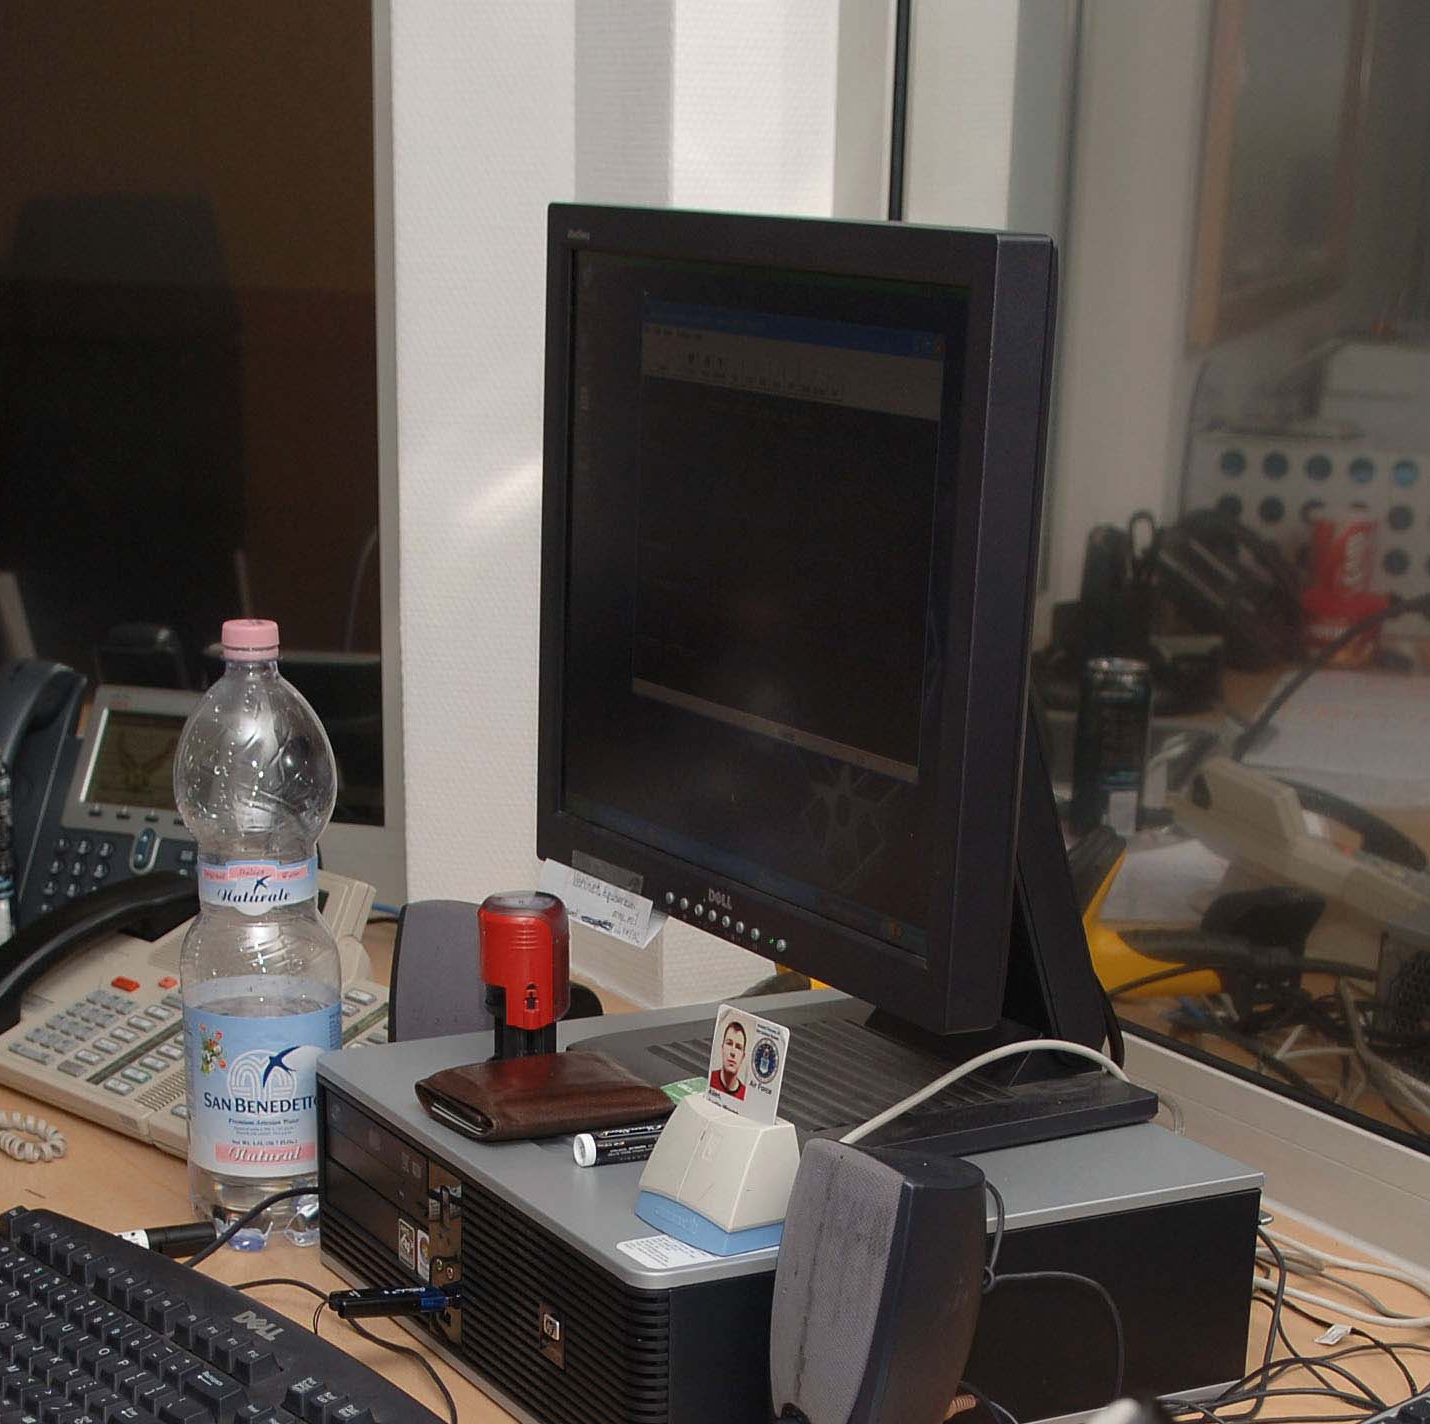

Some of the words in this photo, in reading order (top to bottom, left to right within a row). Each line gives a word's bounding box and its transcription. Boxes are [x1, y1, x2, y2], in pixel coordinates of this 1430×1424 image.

[217, 883, 291, 904] Naturale
[708, 887, 734, 910] DELL
[204, 1092, 231, 1110] SAN
[228, 1146, 302, 1163] Natural
[233, 1309, 285, 1342] DELL
